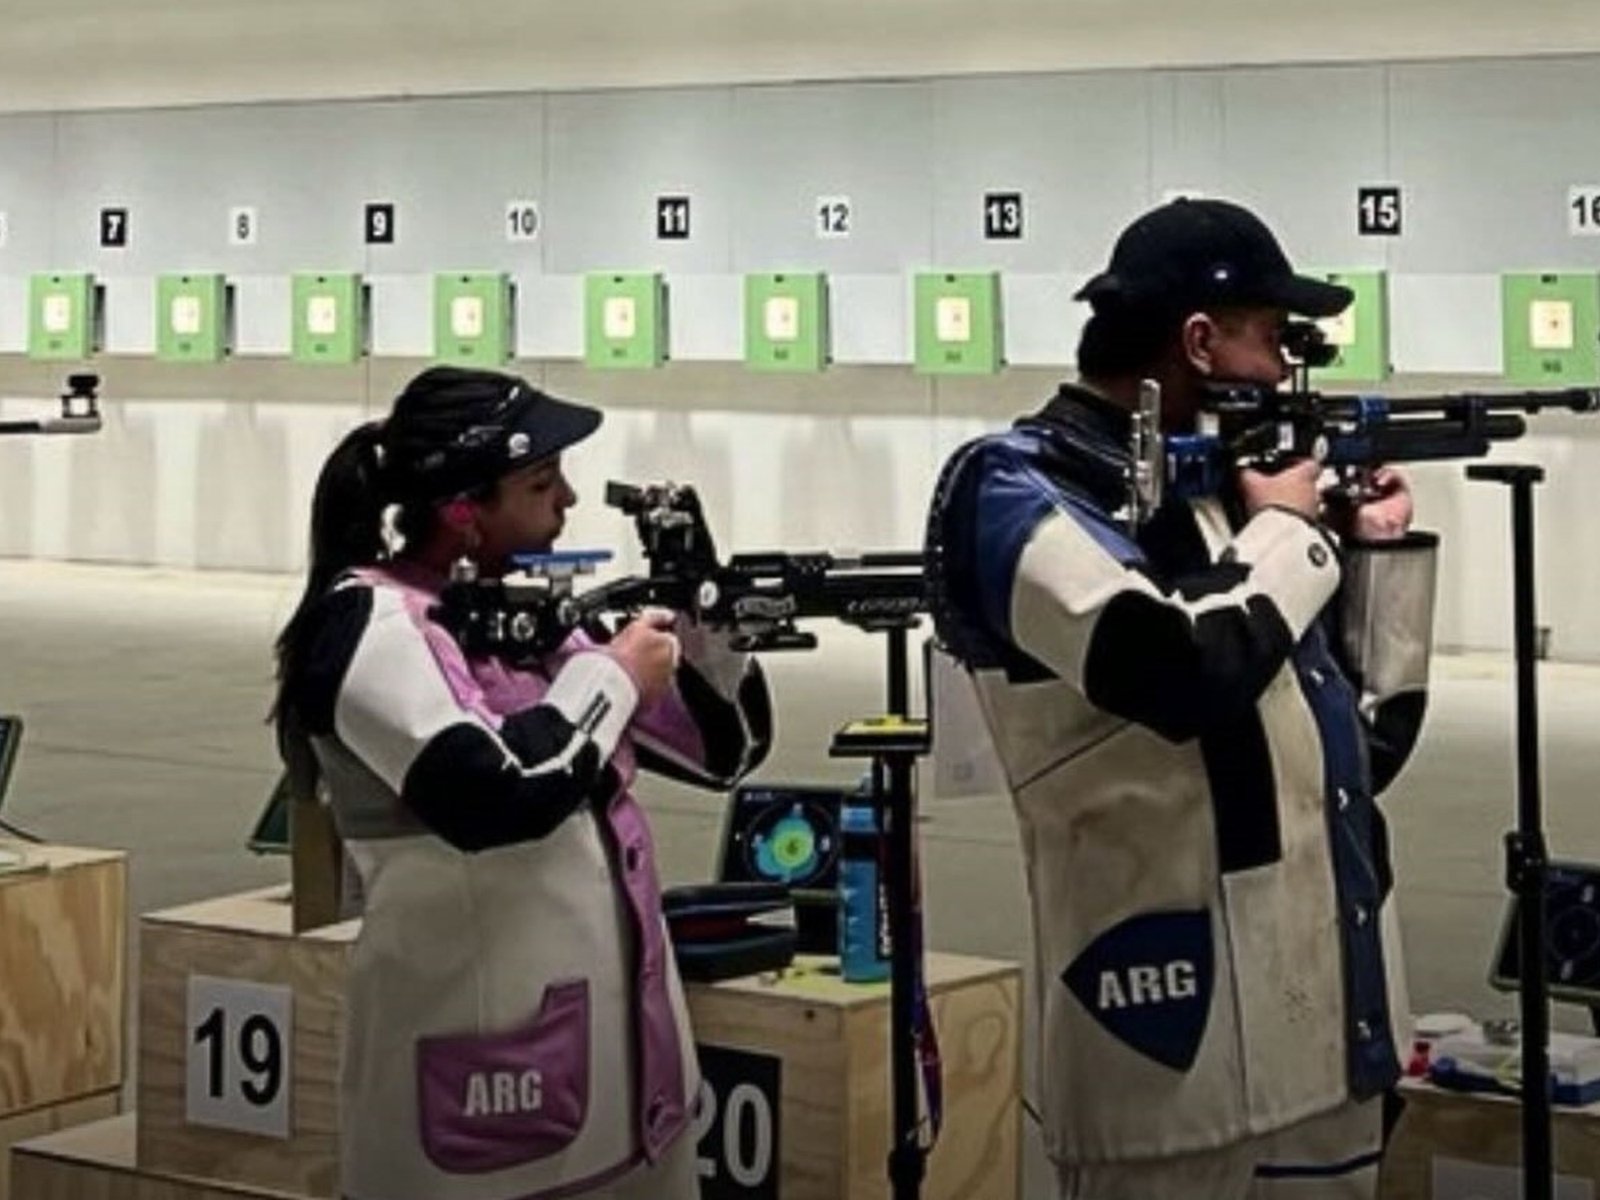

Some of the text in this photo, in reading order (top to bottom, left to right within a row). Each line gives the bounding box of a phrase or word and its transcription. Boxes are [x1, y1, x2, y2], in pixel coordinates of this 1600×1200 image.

[372, 211, 387, 237] 9
[508, 207, 537, 235] 10
[660, 203, 688, 232] 11
[819, 203, 849, 232] 12
[987, 201, 1019, 232] 13
[1361, 195, 1397, 227] 15
[107, 215, 121, 240] 7
[236, 213, 250, 240] 8
[1098, 959, 1197, 1010] ARG
[193, 1007, 282, 1106] 19
[463, 1070, 543, 1118] ARG
